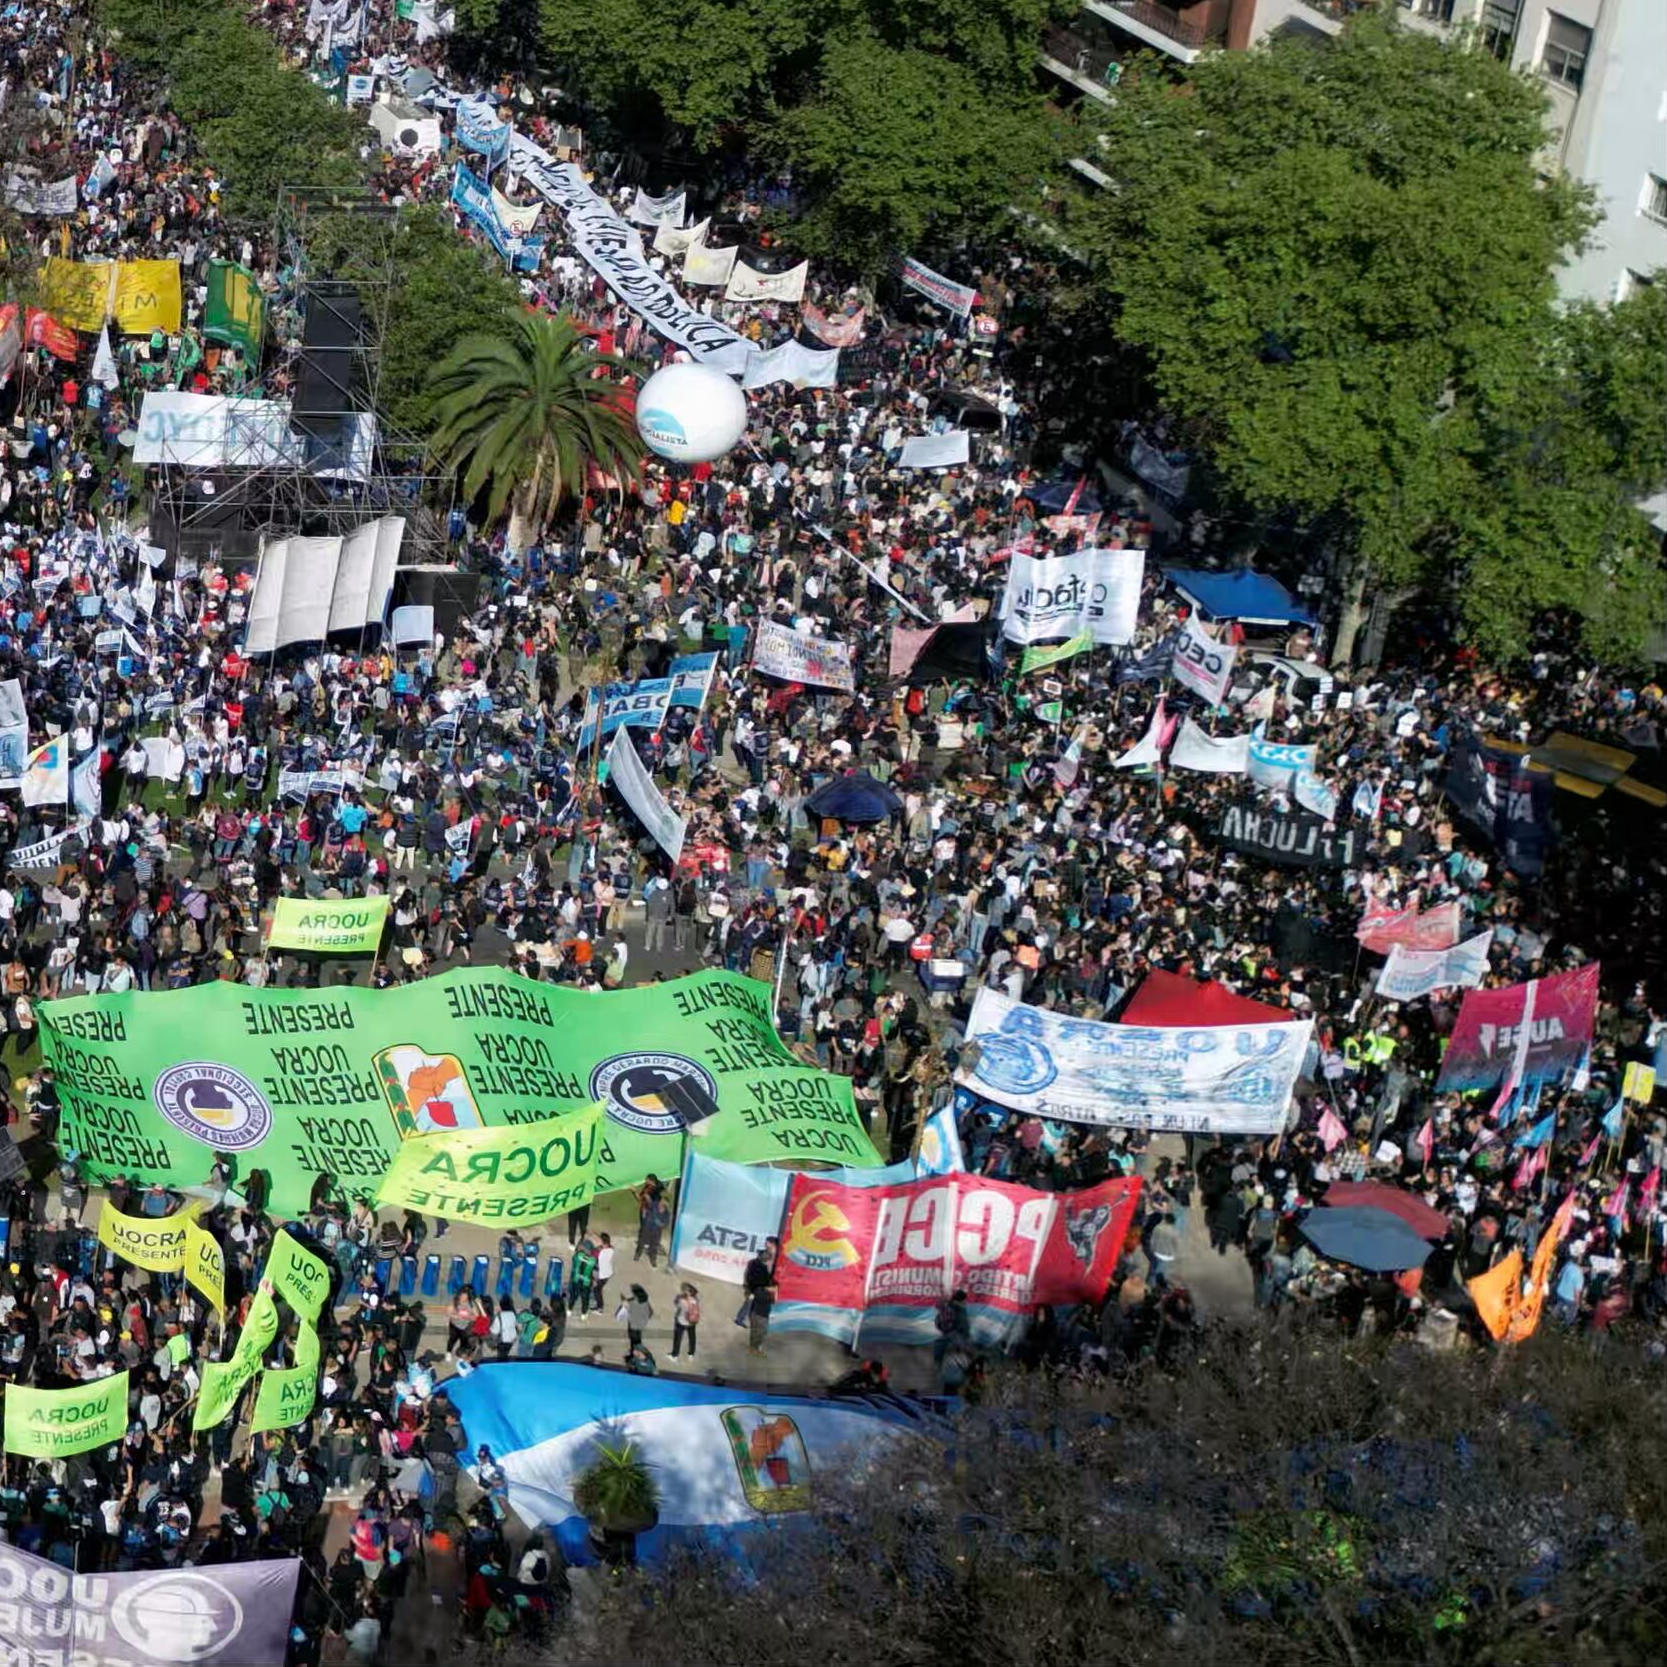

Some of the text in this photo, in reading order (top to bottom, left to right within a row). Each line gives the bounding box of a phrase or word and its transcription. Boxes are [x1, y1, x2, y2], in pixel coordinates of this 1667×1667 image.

[241, 1000, 356, 1035] PRESENTE
[443, 983, 555, 1028] PRESENTE
[269, 1043, 352, 1076] UOCRA
[474, 1032, 554, 1069] UOCRA
[264, 1070, 380, 1106] PRESENTE
[469, 1064, 586, 1099] PRESENTE
[745, 1077, 830, 1103] UOCRA
[72, 1093, 142, 1135] UOCRA
[740, 1101, 859, 1129] PRESENTE
[296, 1116, 380, 1149] UOCRA
[770, 1129, 863, 1157] UOCRA
[291, 1144, 391, 1176] RESENTE
[111, 1224, 187, 1248] UOCRA
[112, 1237, 187, 1261] PRESENTE
